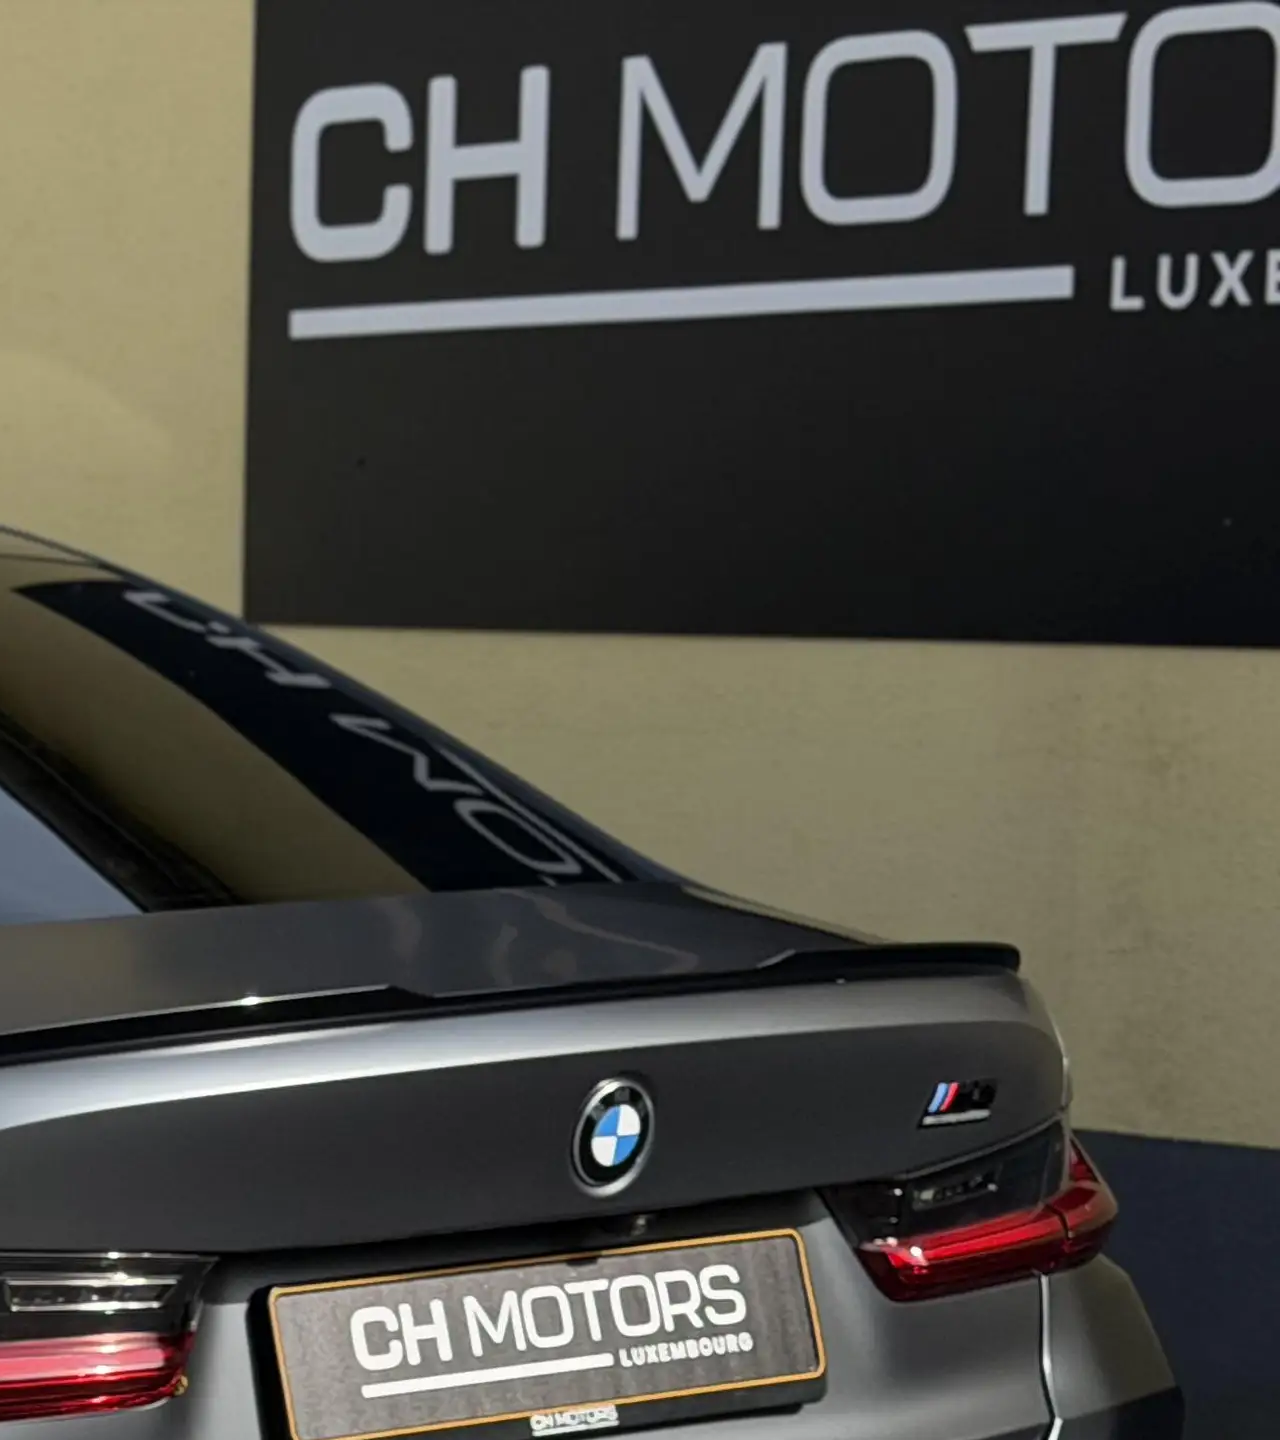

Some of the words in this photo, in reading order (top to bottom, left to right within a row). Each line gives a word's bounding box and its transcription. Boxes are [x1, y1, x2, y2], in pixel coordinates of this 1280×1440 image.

[291, 65, 550, 263] CH
[617, 1, 1280, 241] MOTO
[350, 1298, 452, 1371] CH
[463, 1264, 748, 1357] MOTORS
[619, 1332, 754, 1368] LUXEMBOURG
